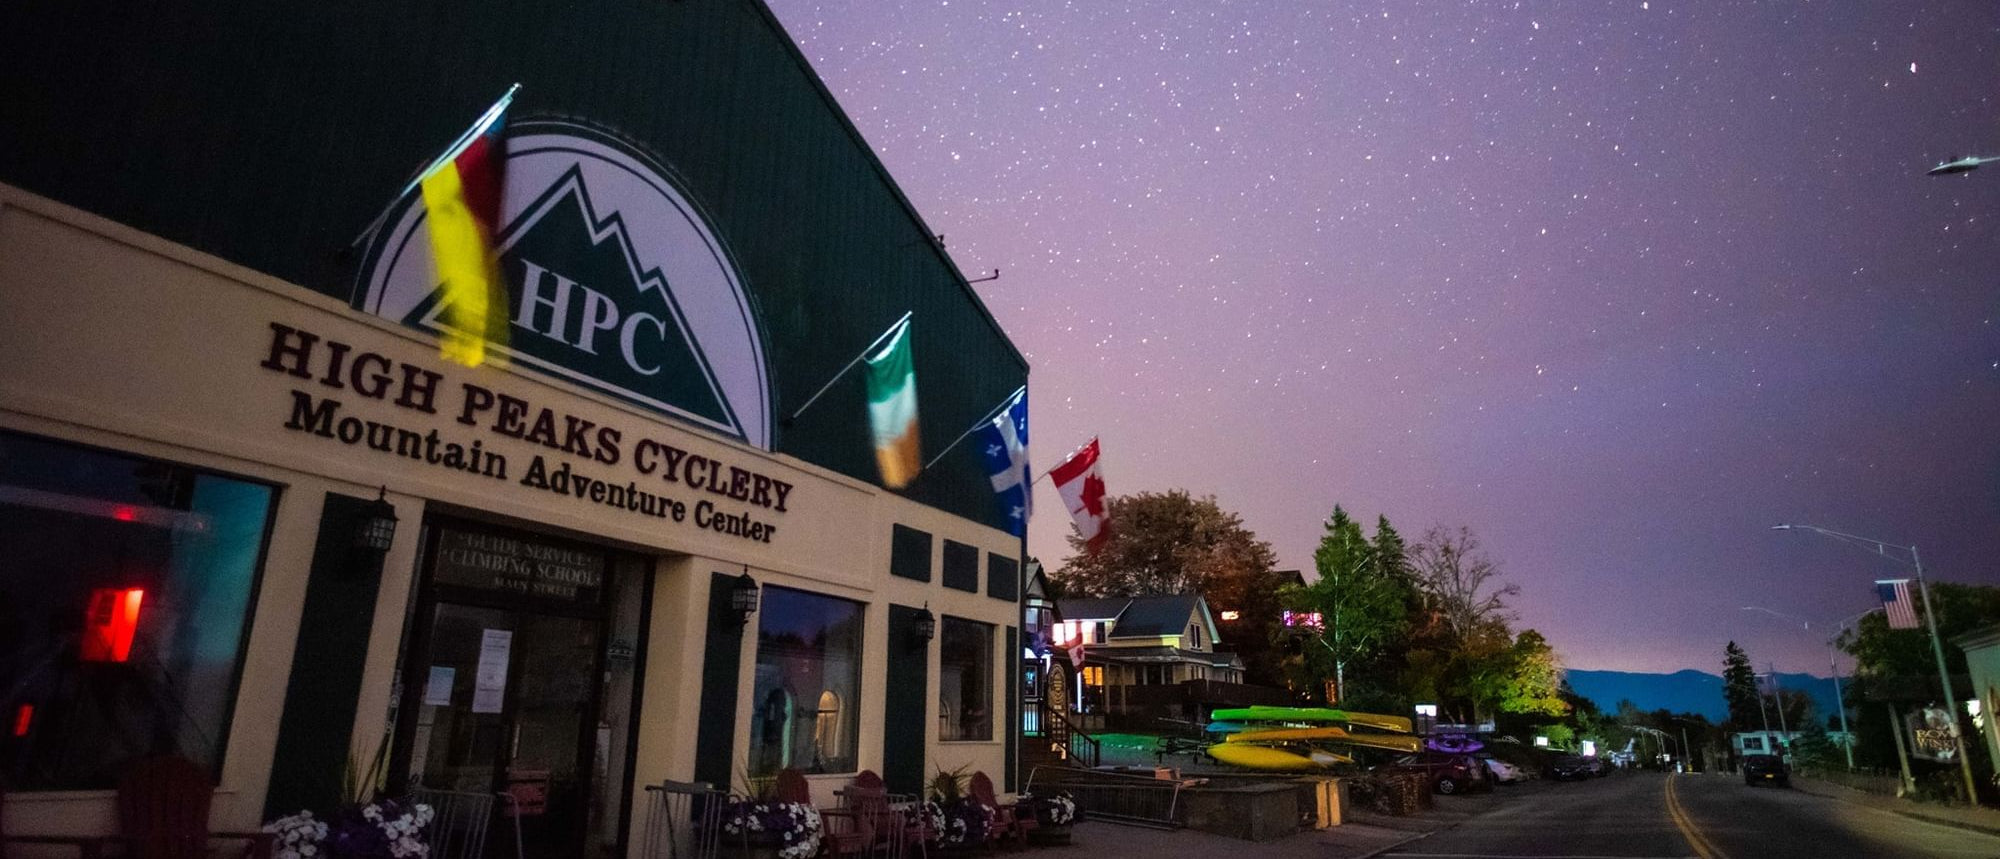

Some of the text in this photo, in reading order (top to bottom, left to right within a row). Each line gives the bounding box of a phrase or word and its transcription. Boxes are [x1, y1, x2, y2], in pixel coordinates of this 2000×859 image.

[510, 258, 667, 376] HPC
[260, 321, 794, 513] HIGH PEAKS CYCLERY
[283, 389, 777, 543] Mountain Adventure Center
[450, 549, 595, 586] CLIMBING SCHOOL
[466, 533, 586, 566] GUIDE SERVICE
